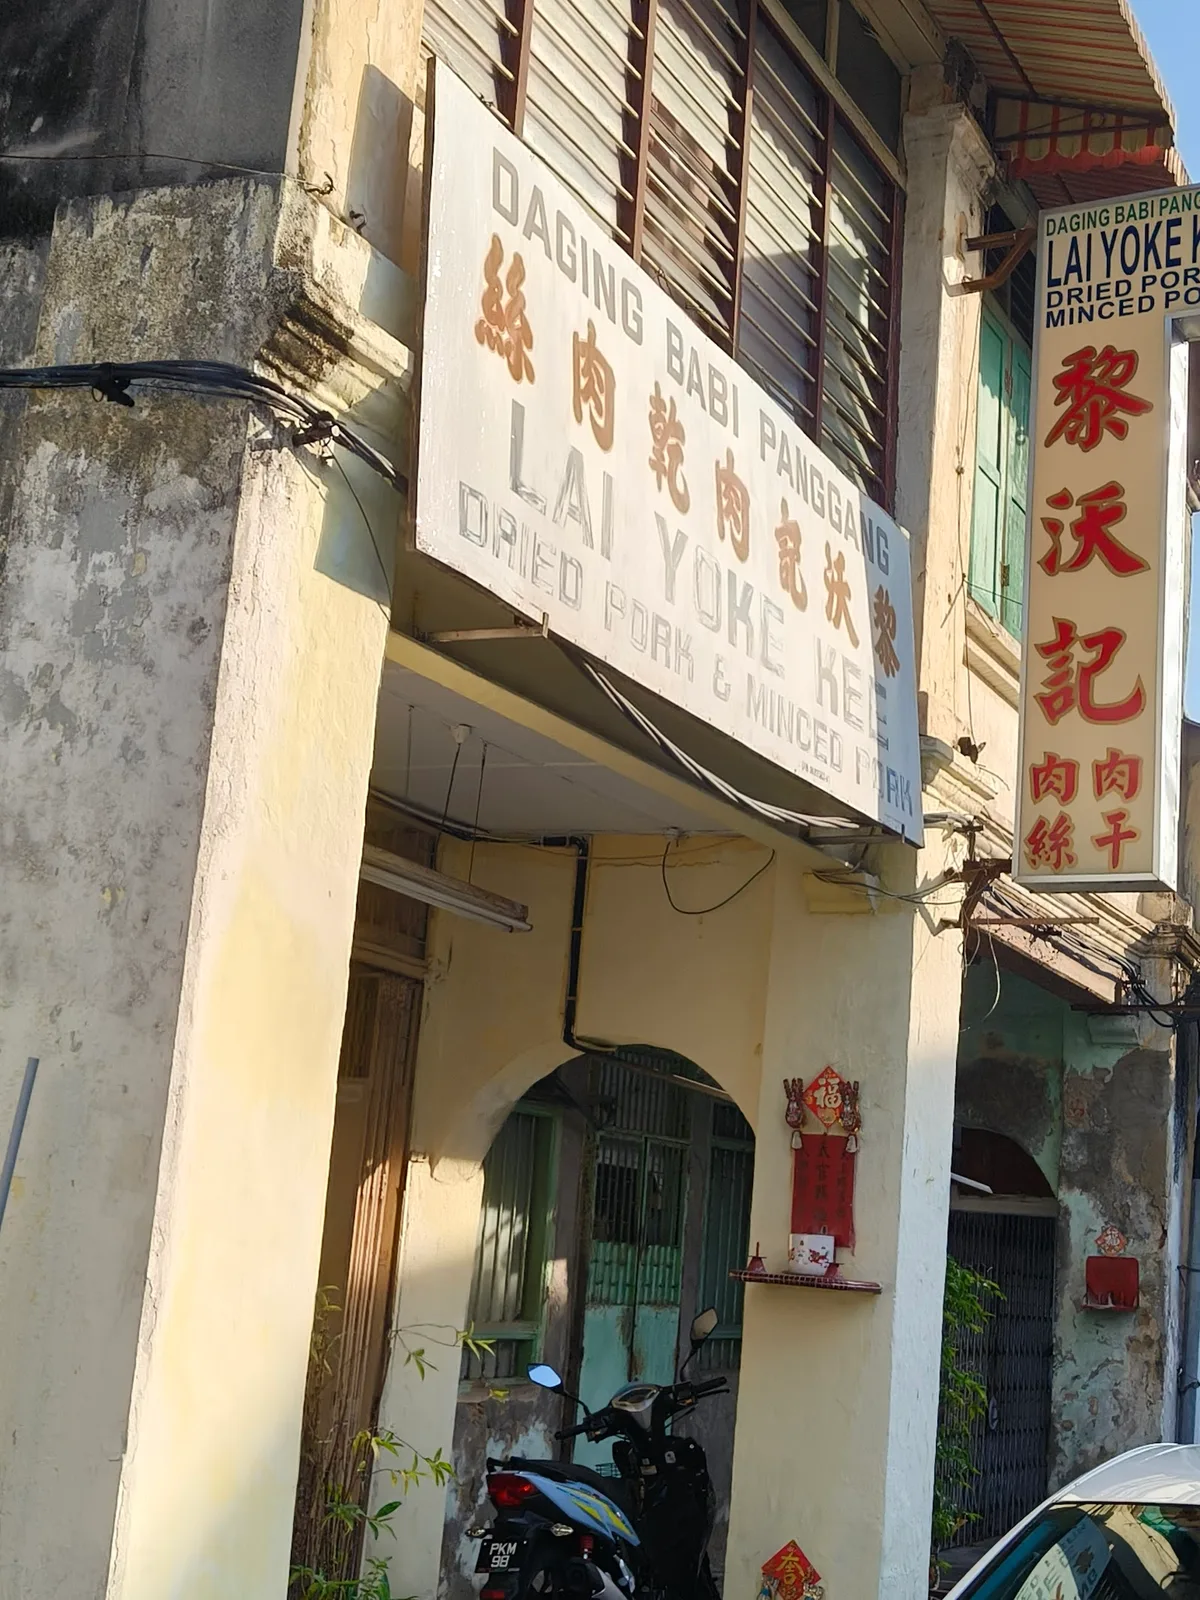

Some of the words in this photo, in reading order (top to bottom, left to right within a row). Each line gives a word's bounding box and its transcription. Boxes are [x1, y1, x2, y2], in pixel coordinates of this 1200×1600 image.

[1046, 208, 1110, 237] DAGING
[1115, 199, 1154, 224] BABI
[1047, 233, 1092, 288] LAI
[1101, 217, 1182, 278] YOKE
[1046, 279, 1131, 309] DRIED
[1141, 267, 1200, 293] POR
[1046, 295, 1155, 328] MINCED
[1165, 287, 1200, 309] PO
[492, 146, 643, 346] DAGING
[665, 317, 739, 436] BABI
[759, 408, 890, 577] PANGGANG
[1036, 344, 1154, 726] 黎沃記
[509, 398, 615, 561] LAI
[654, 511, 786, 681] YOKE
[815, 637, 890, 753] KEE
[458, 481, 584, 613] DRIED
[604, 578, 695, 684] PORK
[713, 652, 732, 703] &
[746, 672, 843, 775] MINCED
[855, 745, 914, 818] PORK
[813, 1078, 842, 1109] 福
[489, 1542, 517, 1555] PKM
[490, 1555, 510, 1568] 98
